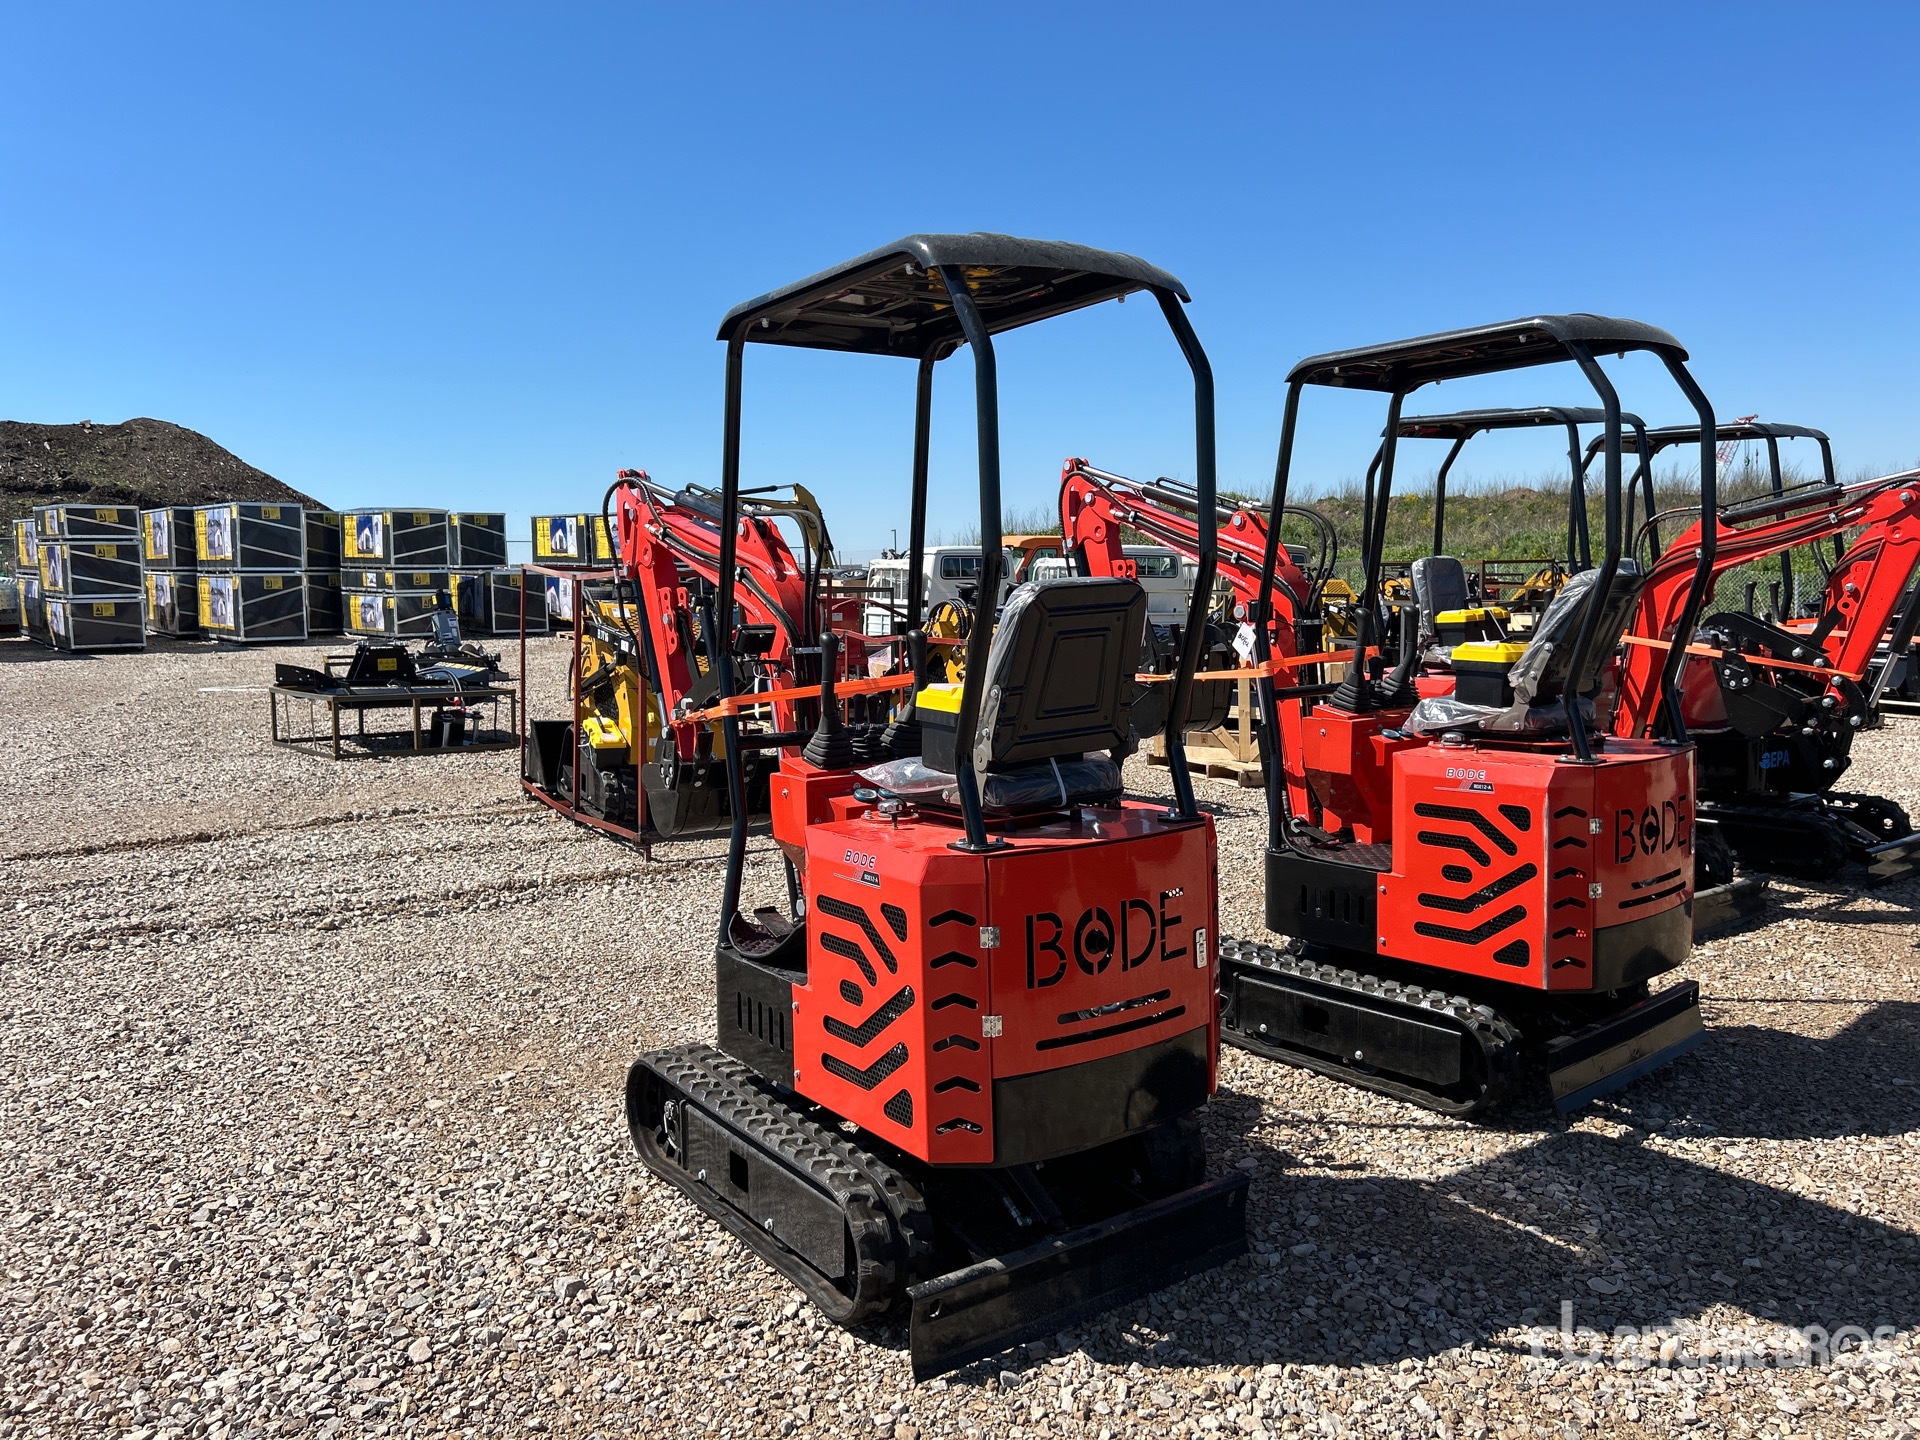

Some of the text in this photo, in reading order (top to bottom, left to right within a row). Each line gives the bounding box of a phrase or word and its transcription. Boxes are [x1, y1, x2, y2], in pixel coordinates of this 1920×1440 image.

[1770, 750, 1790, 768] EPA
[1446, 768, 1486, 780] BODE
[1615, 794, 1687, 864] BODE
[844, 849, 877, 869] BODE
[1025, 887, 1187, 989] BODE
